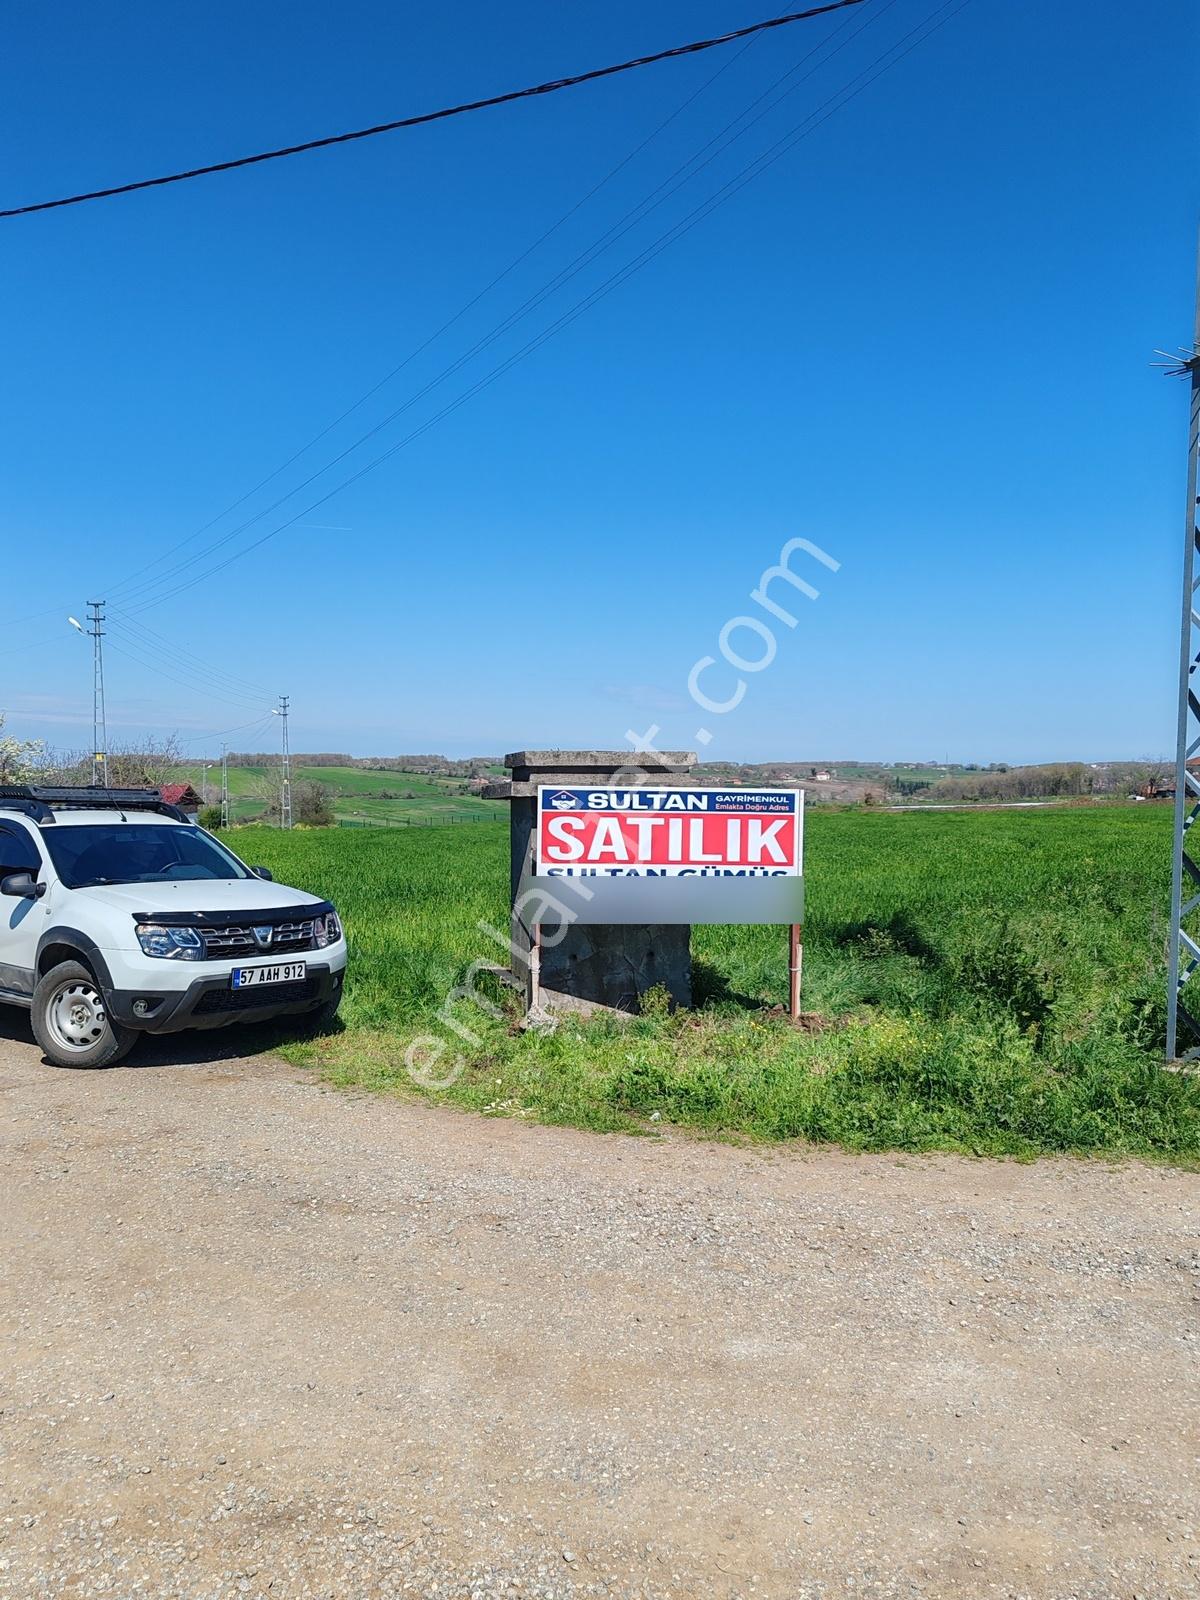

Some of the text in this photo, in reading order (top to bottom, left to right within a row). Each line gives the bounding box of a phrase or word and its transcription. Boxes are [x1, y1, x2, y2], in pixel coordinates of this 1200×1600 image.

[587, 792, 708, 811] SULTAN
[715, 795, 790, 803] GAYRİMENKUL
[547, 815, 788, 863] SATILIK
[240, 965, 303, 984] 57 AAH 912
